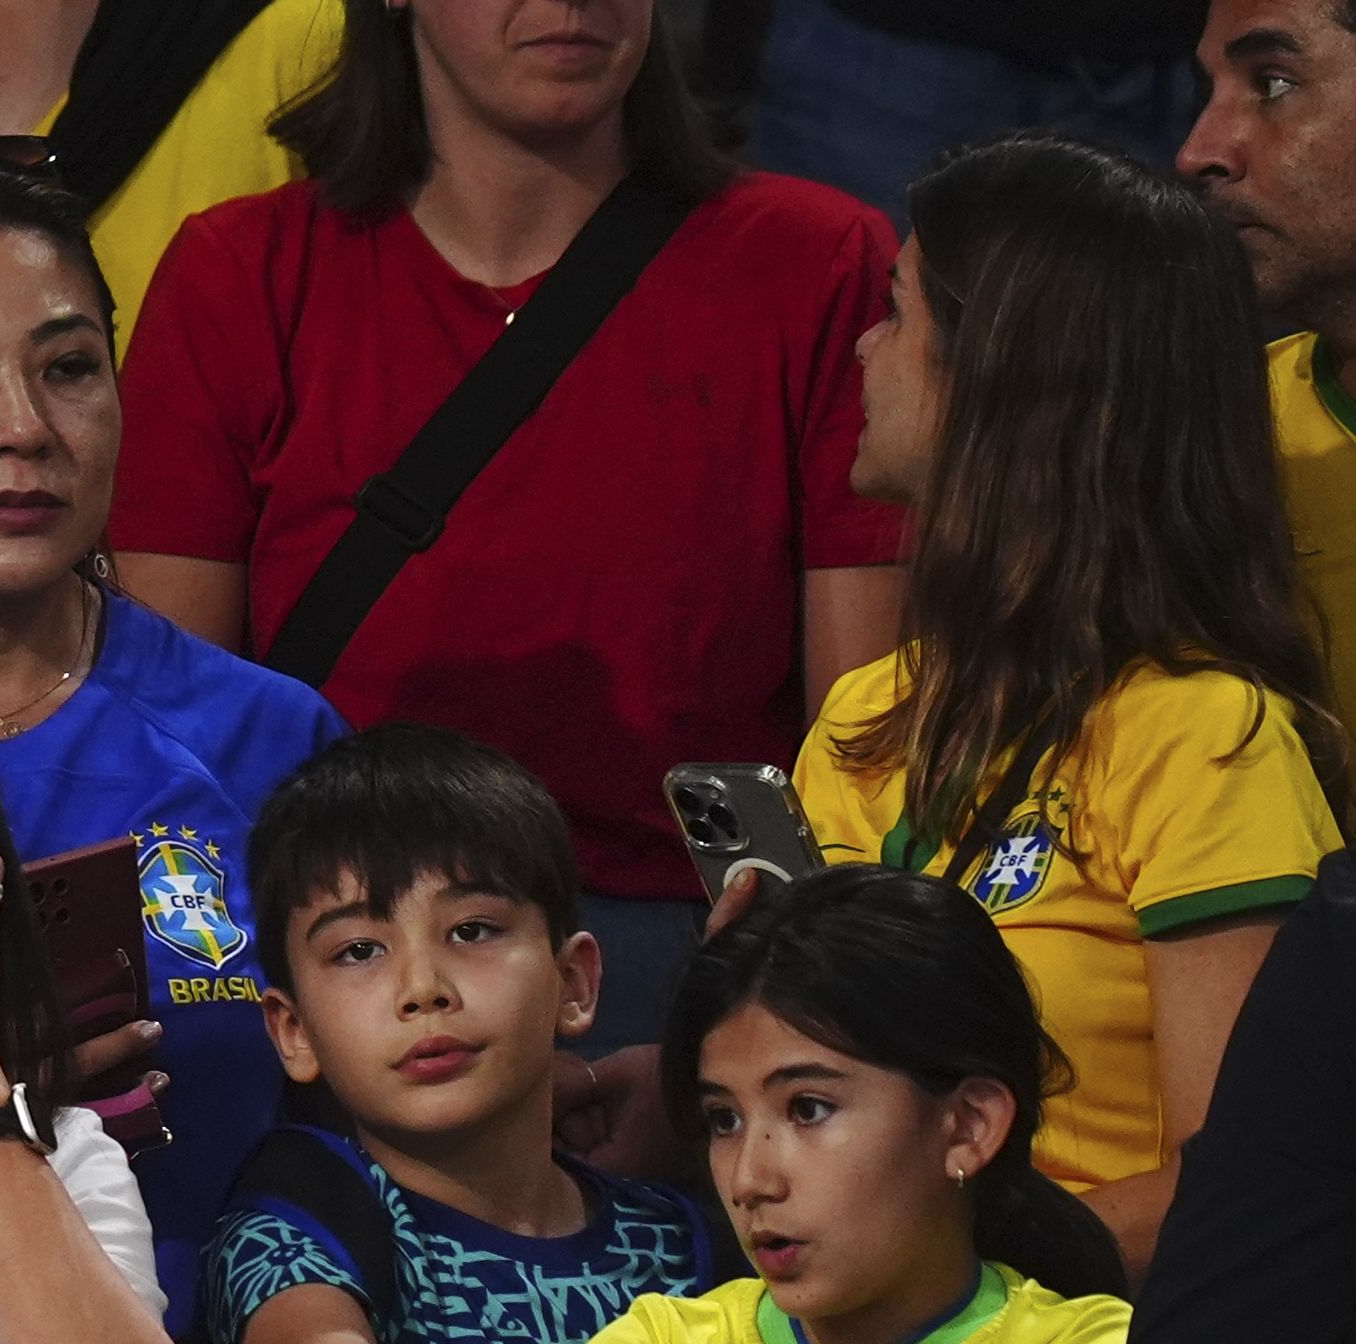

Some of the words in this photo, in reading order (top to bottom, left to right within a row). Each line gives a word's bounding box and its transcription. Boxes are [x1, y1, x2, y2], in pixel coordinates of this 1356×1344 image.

[999, 854, 1028, 867] CBF
[170, 894, 207, 910] CBF
[168, 976, 263, 1004] BRASIL
